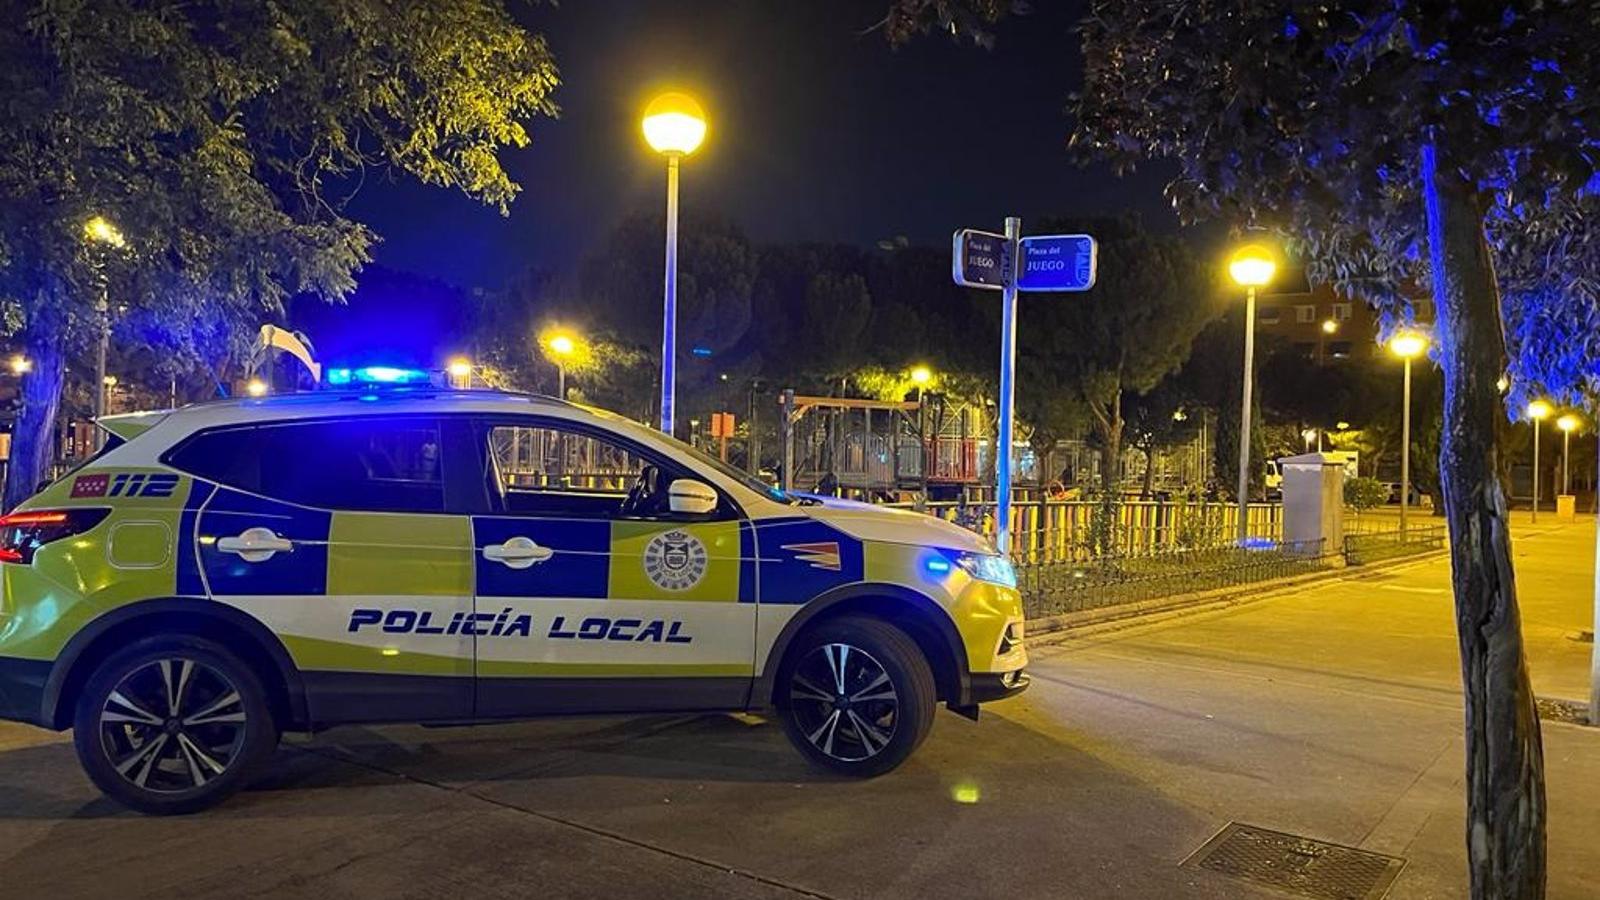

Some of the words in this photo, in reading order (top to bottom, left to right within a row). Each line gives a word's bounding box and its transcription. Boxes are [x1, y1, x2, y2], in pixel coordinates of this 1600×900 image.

[1028, 247, 1047, 255] Plaza
[1049, 246, 1060, 254] del
[969, 255, 994, 268] JUEGO
[1027, 260, 1065, 271] JUEGO
[109, 474, 179, 497] 112
[348, 607, 532, 637] POLICÍA
[548, 616, 692, 643] LOCAL
